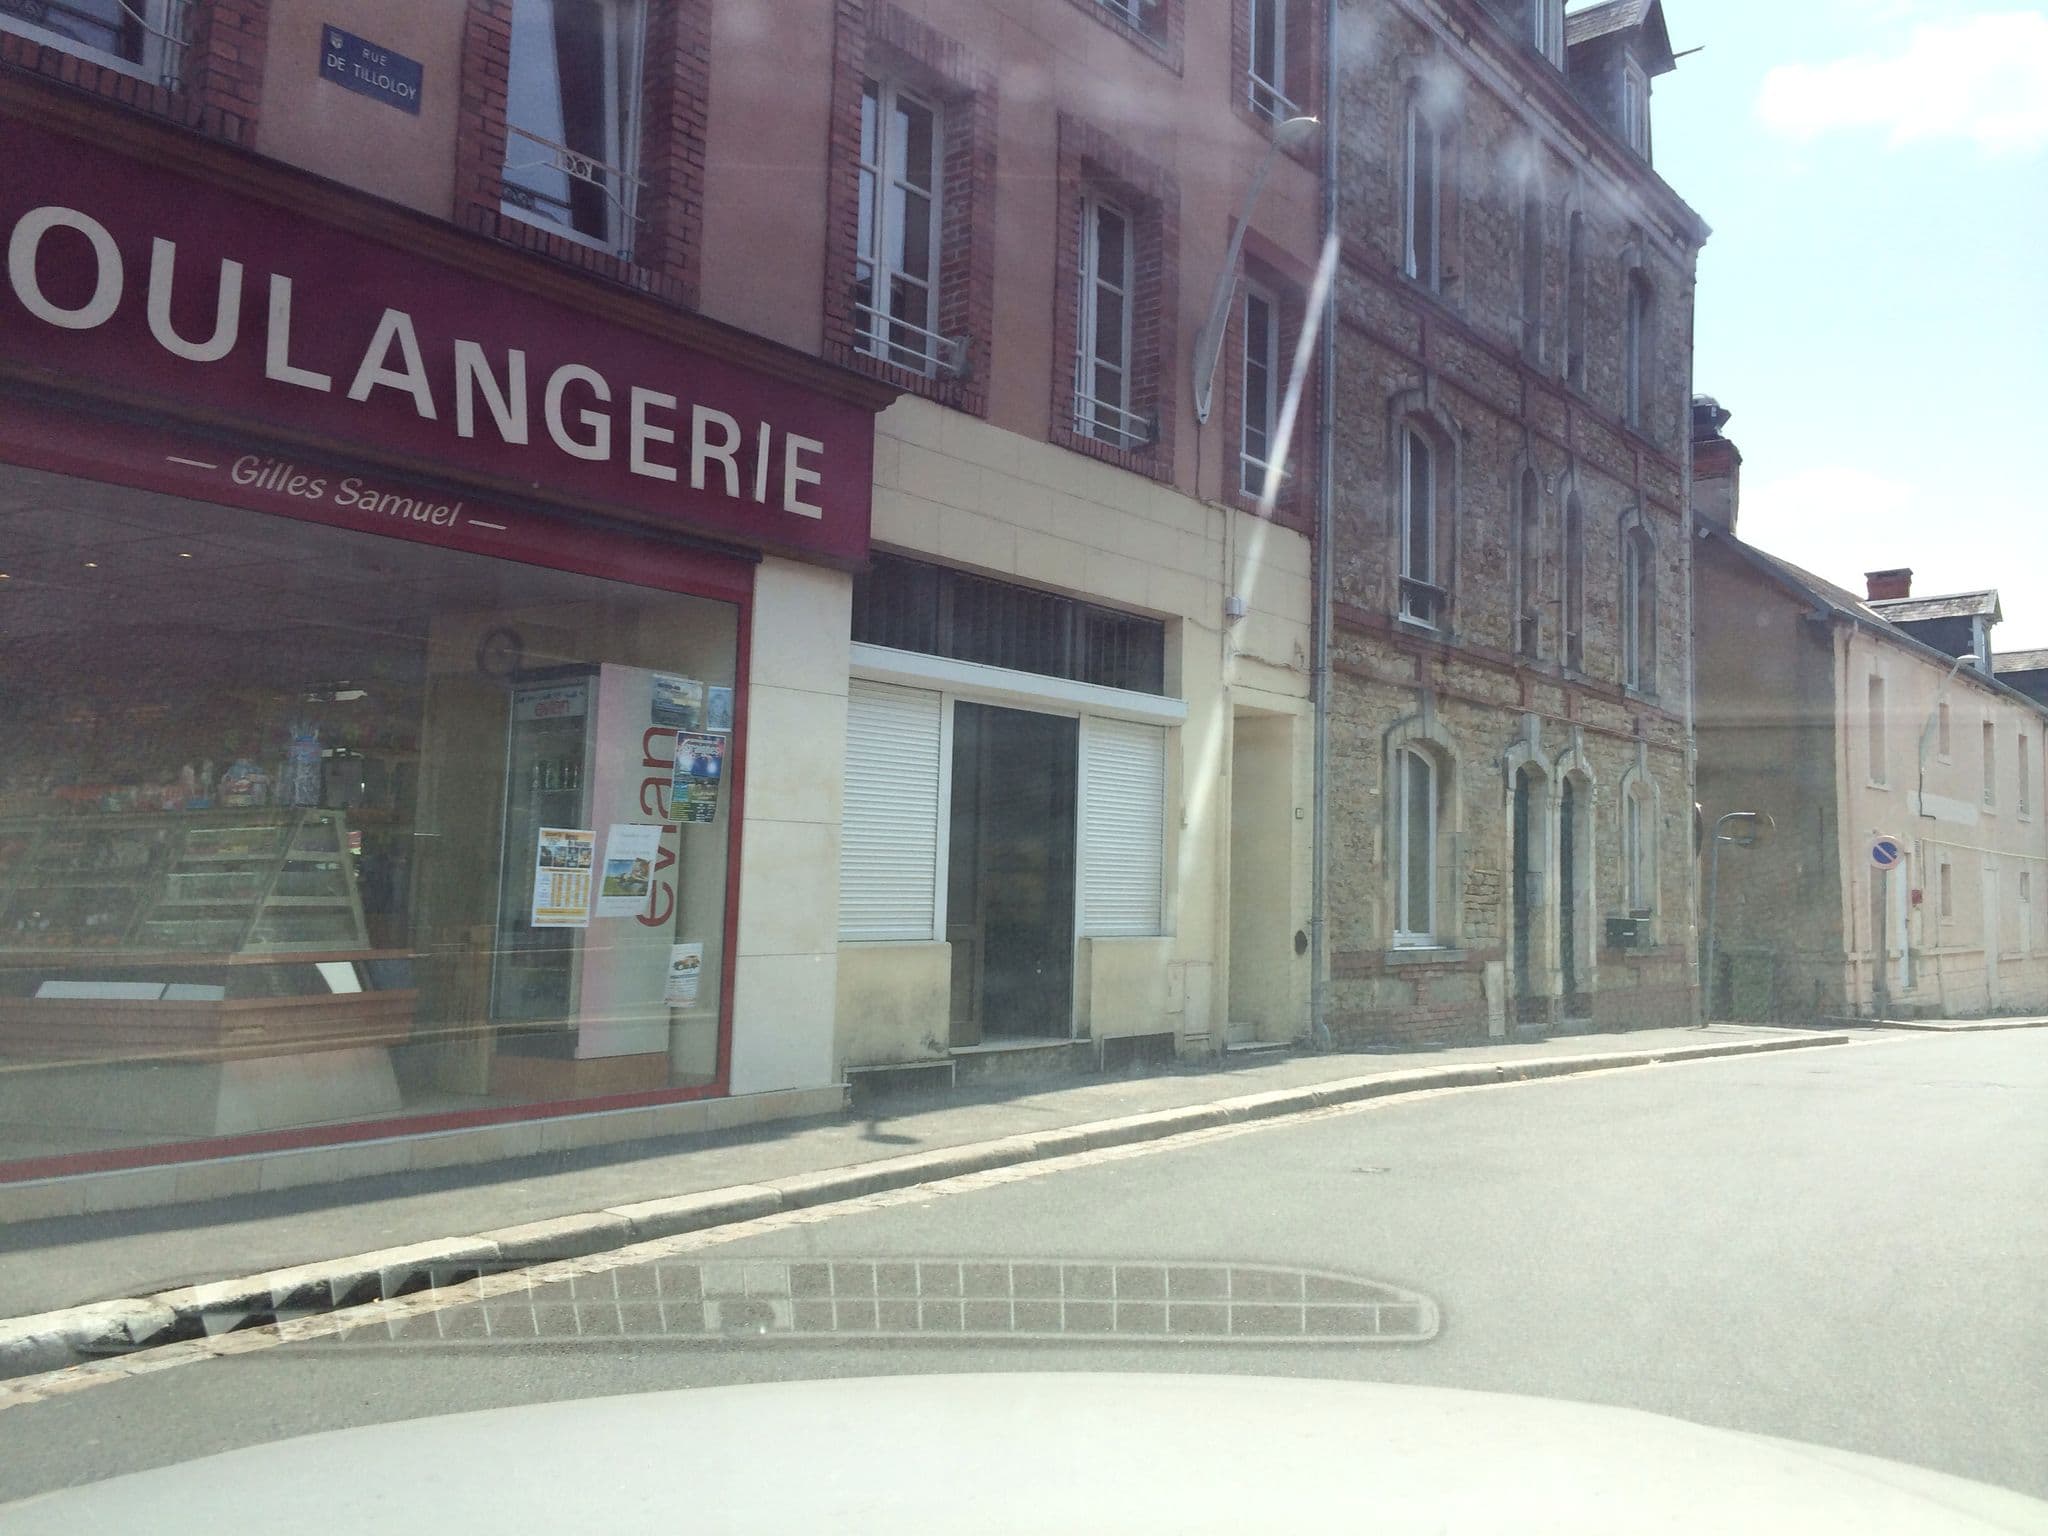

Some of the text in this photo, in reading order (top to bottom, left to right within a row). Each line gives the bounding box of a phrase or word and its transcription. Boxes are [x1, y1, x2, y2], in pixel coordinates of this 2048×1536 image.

[327, 53, 417, 99] DE TILLOLOY
[362, 48, 387, 66] RUE
[8, 206, 824, 520] OULANGERIE
[231, 455, 463, 527] Gilles Samuel
